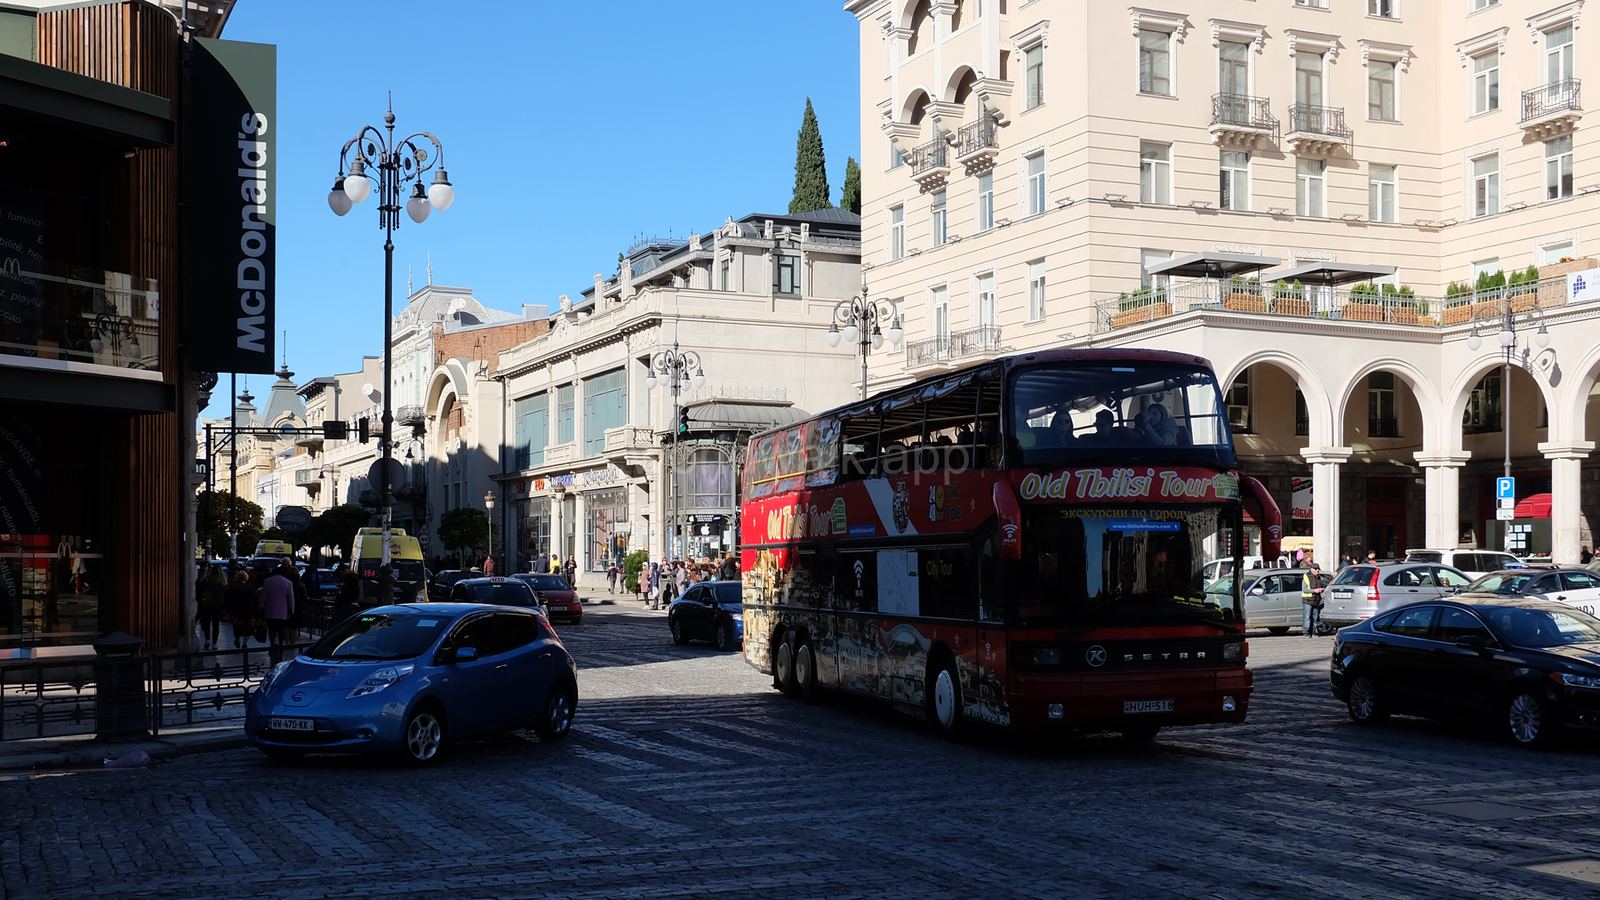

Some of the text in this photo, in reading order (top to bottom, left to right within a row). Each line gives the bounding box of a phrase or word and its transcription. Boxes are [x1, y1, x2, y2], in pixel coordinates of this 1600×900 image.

[237, 112, 268, 353] McDonald's
[1020, 468, 1211, 499] Old Tbilisi Tour
[1500, 480, 1510, 497] P
[767, 502, 830, 540] Old Tbilisi Tour
[1123, 652, 1206, 661] SETRA
